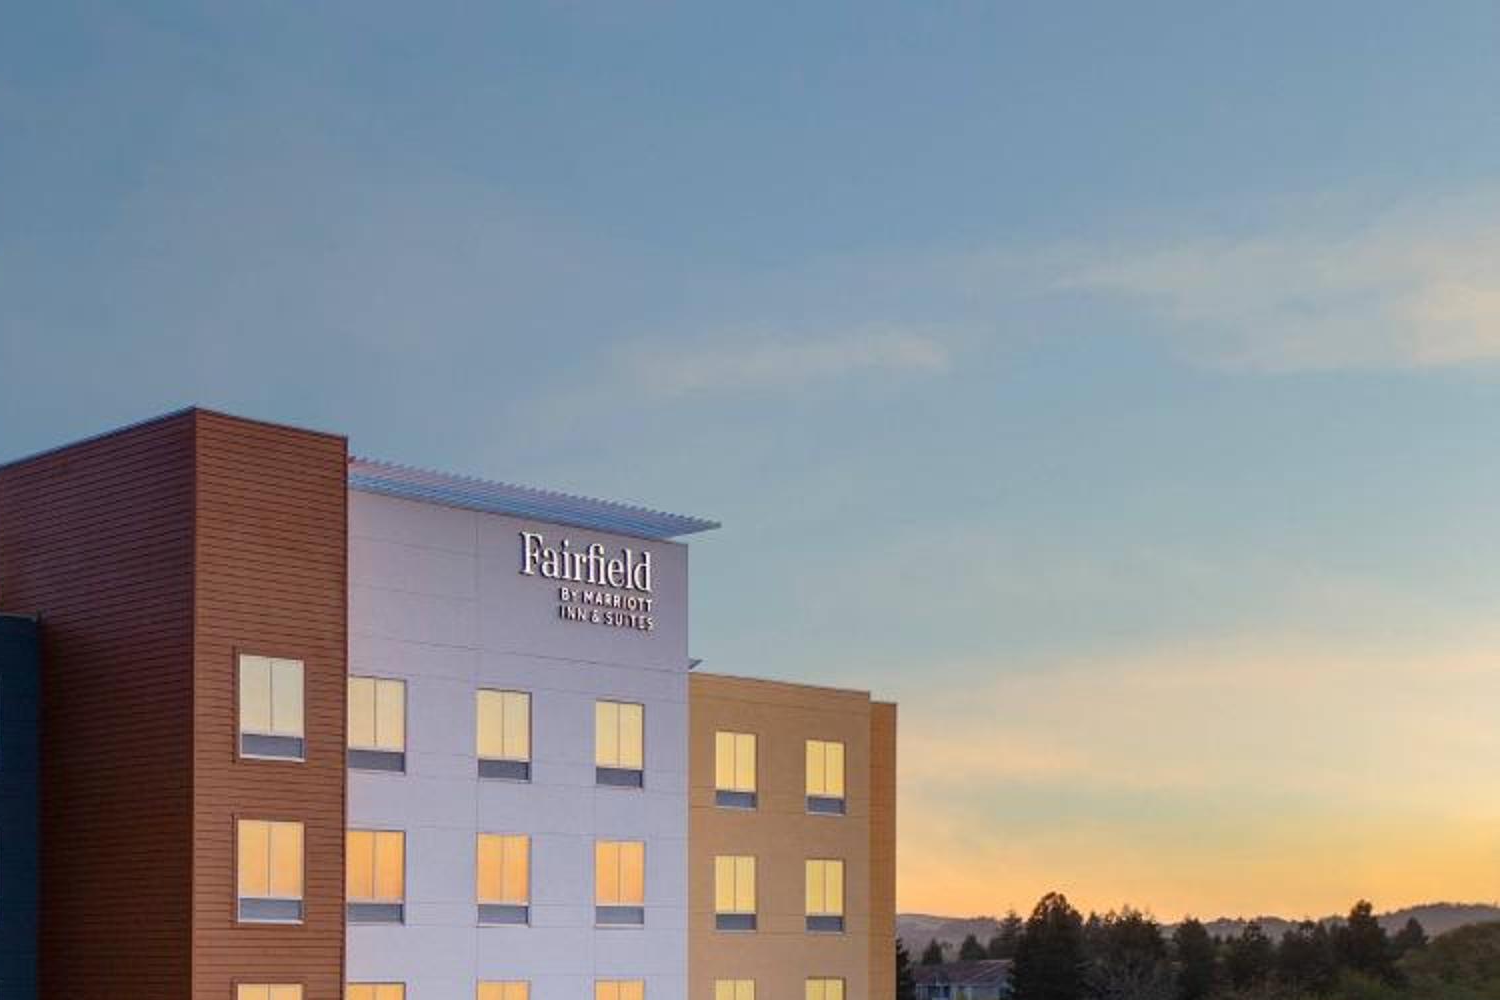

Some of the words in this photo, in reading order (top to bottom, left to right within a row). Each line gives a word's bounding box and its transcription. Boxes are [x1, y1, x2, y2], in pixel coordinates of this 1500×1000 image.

[519, 531, 653, 593] Fairfield
[560, 586, 578, 602] BY
[583, 591, 653, 613] MARRIOTT
[560, 605, 587, 622] INN
[590, 609, 600, 624] &
[605, 611, 654, 631] SUITES
